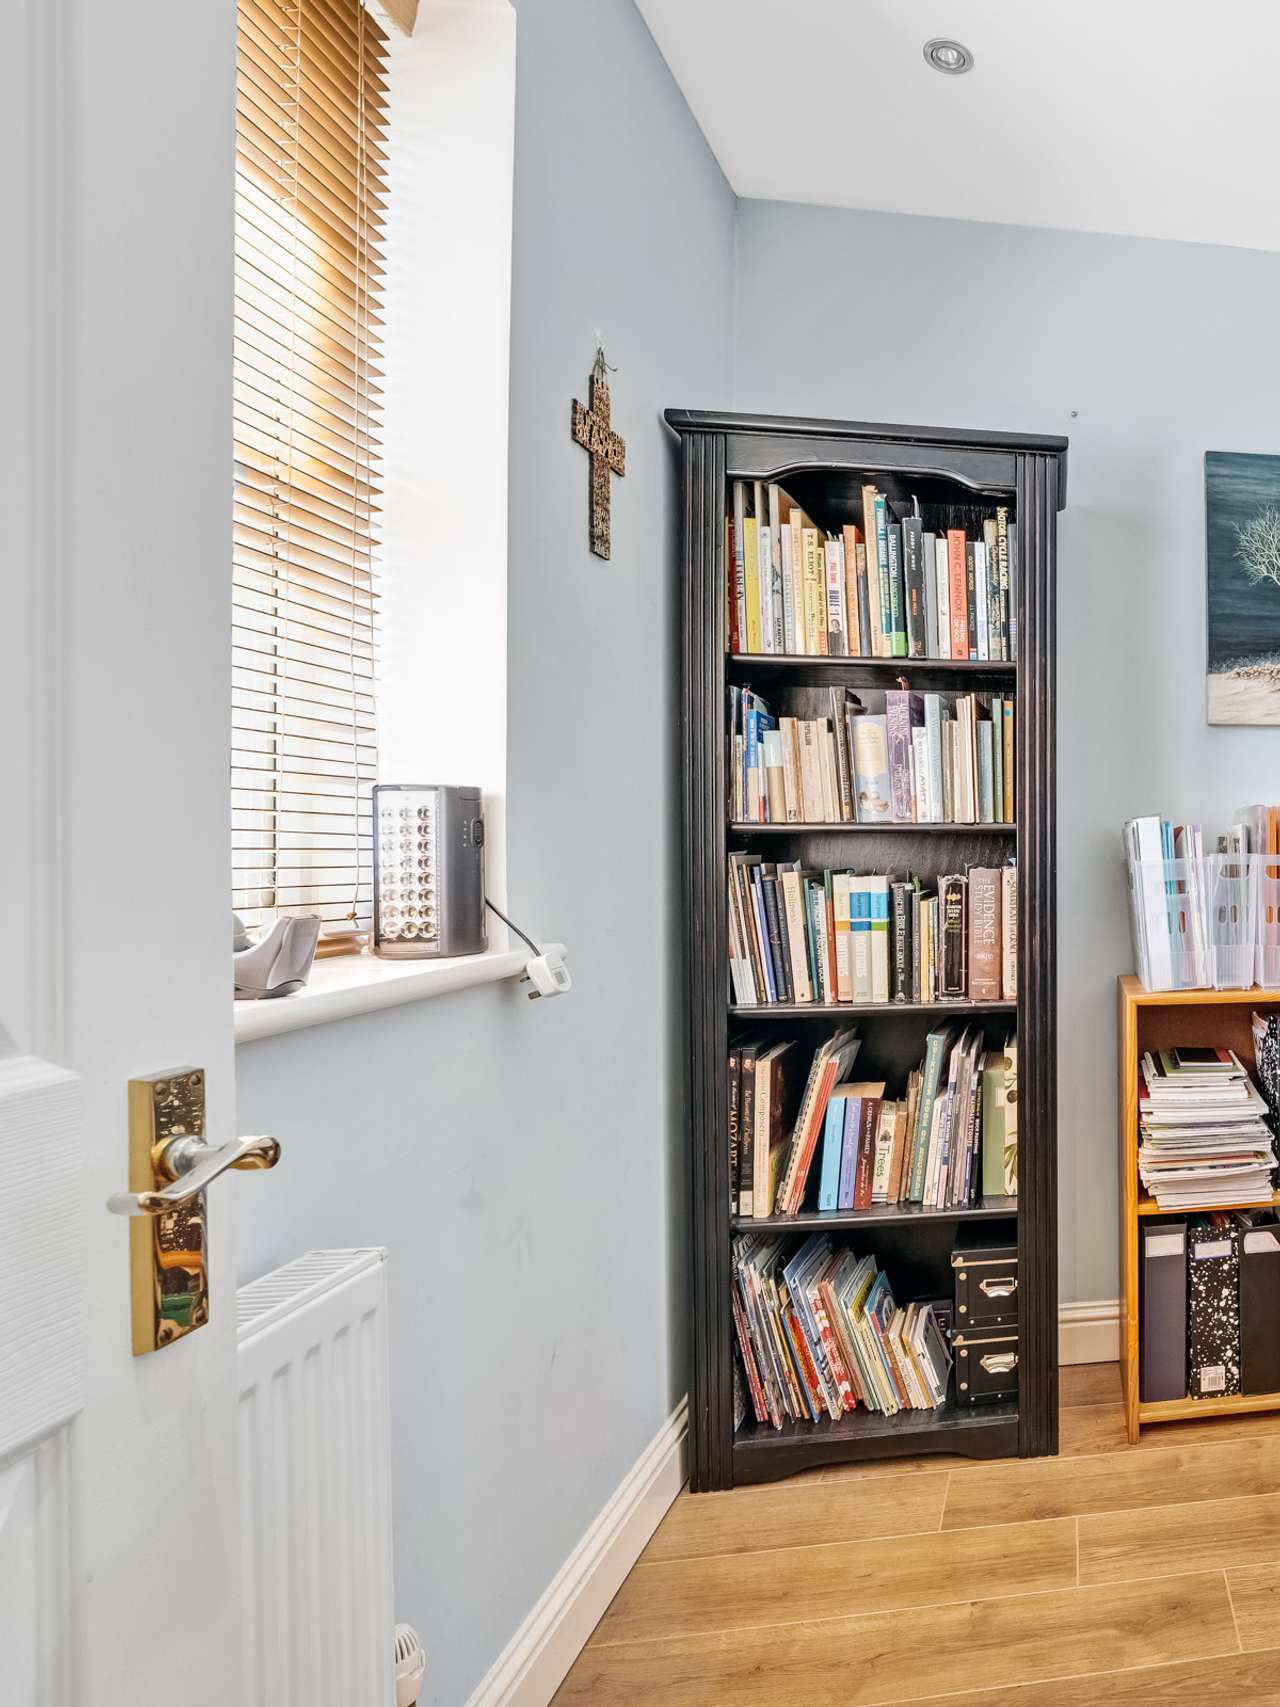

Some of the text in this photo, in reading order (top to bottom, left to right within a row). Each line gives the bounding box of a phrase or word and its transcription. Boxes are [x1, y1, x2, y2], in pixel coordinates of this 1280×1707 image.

[997, 506, 1009, 536] MOTOR
[807, 551, 816, 577] ELIOT
[888, 534, 899, 578] BALLINGTON
[952, 536, 962, 560] JOHN
[998, 536, 1009, 561] CYCLE
[999, 561, 1010, 590] RACING
[828, 590, 841, 608] RULE
[954, 573, 963, 612] LENNOX
[974, 884, 984, 945] STUDY BIBLE
[983, 884, 997, 945] EVIDENCE
[757, 1091, 768, 1137] Composers
[729, 1109, 739, 1167] MOZART
[875, 1145, 890, 1178] Trees
